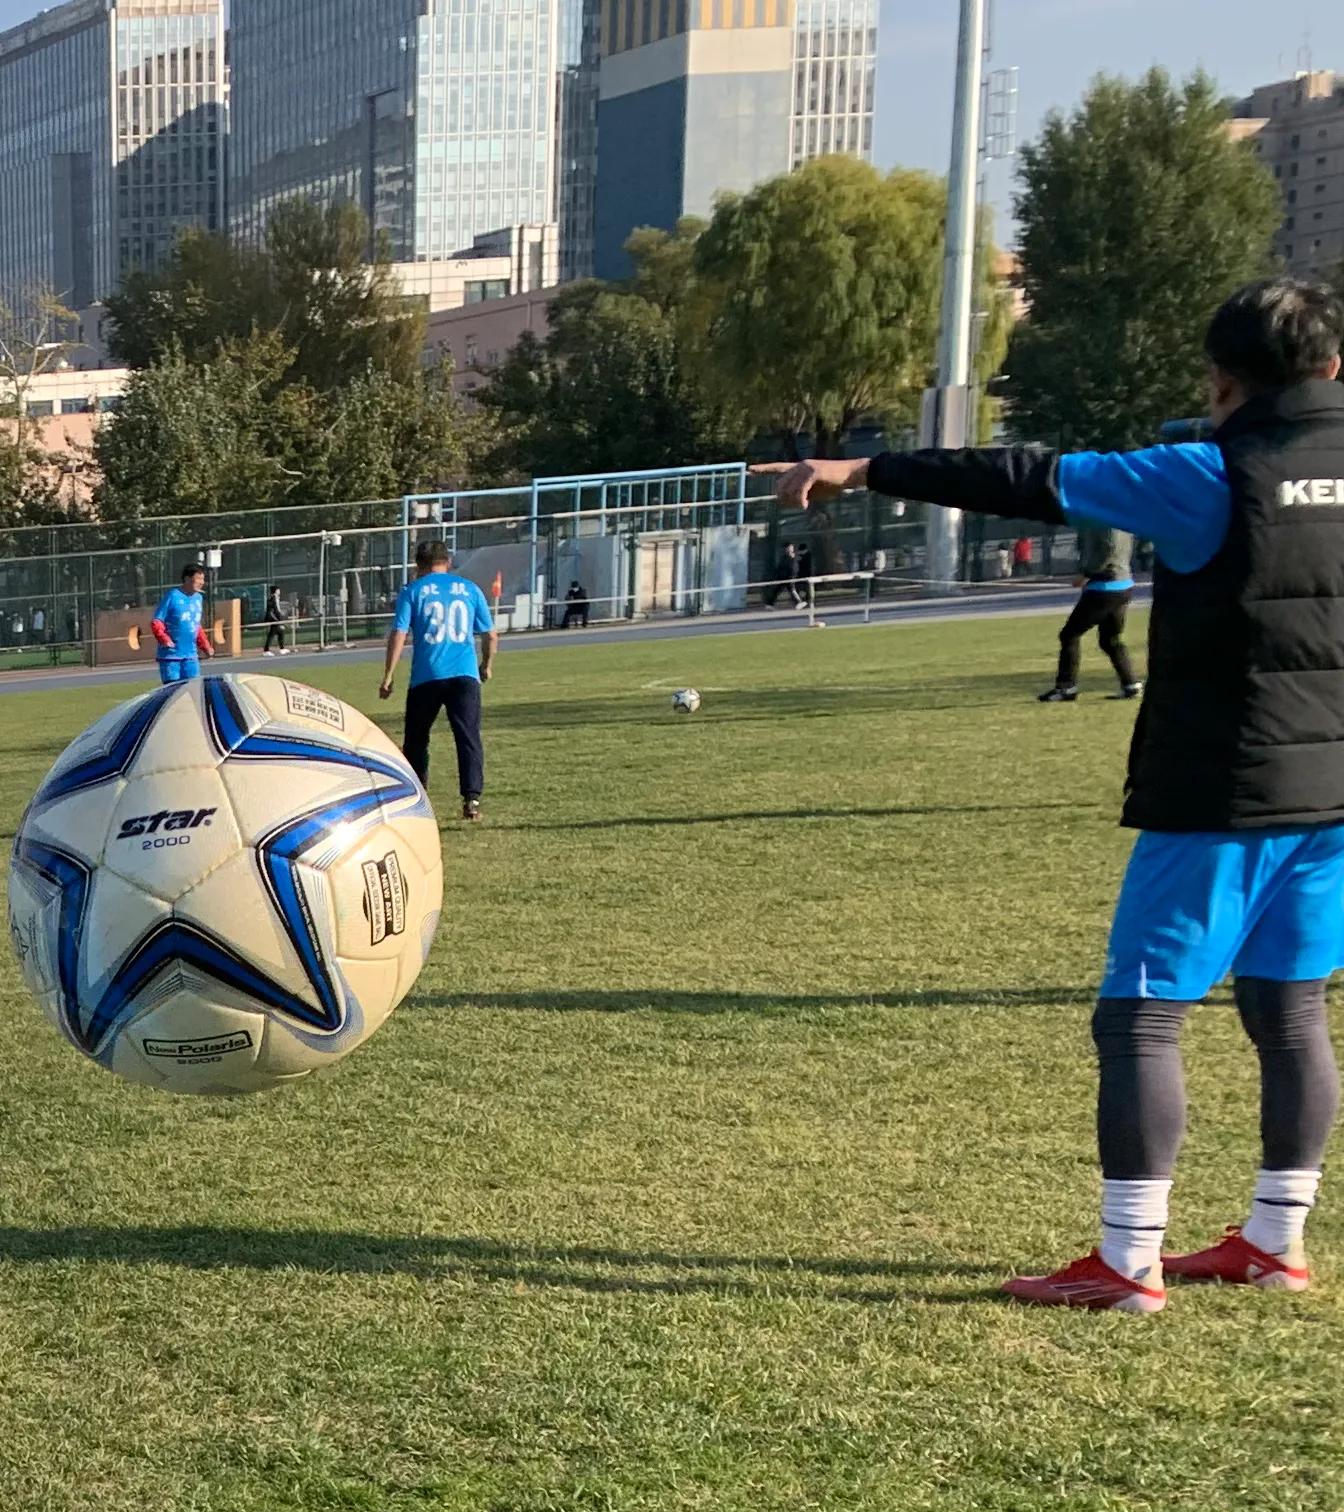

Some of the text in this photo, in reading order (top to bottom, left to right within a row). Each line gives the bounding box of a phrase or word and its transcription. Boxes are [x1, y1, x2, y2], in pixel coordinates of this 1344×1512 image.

[424, 600, 468, 645] 30
[116, 807, 218, 840] star
[142, 835, 191, 851] 2000
[178, 1038, 246, 1055] Polaris
